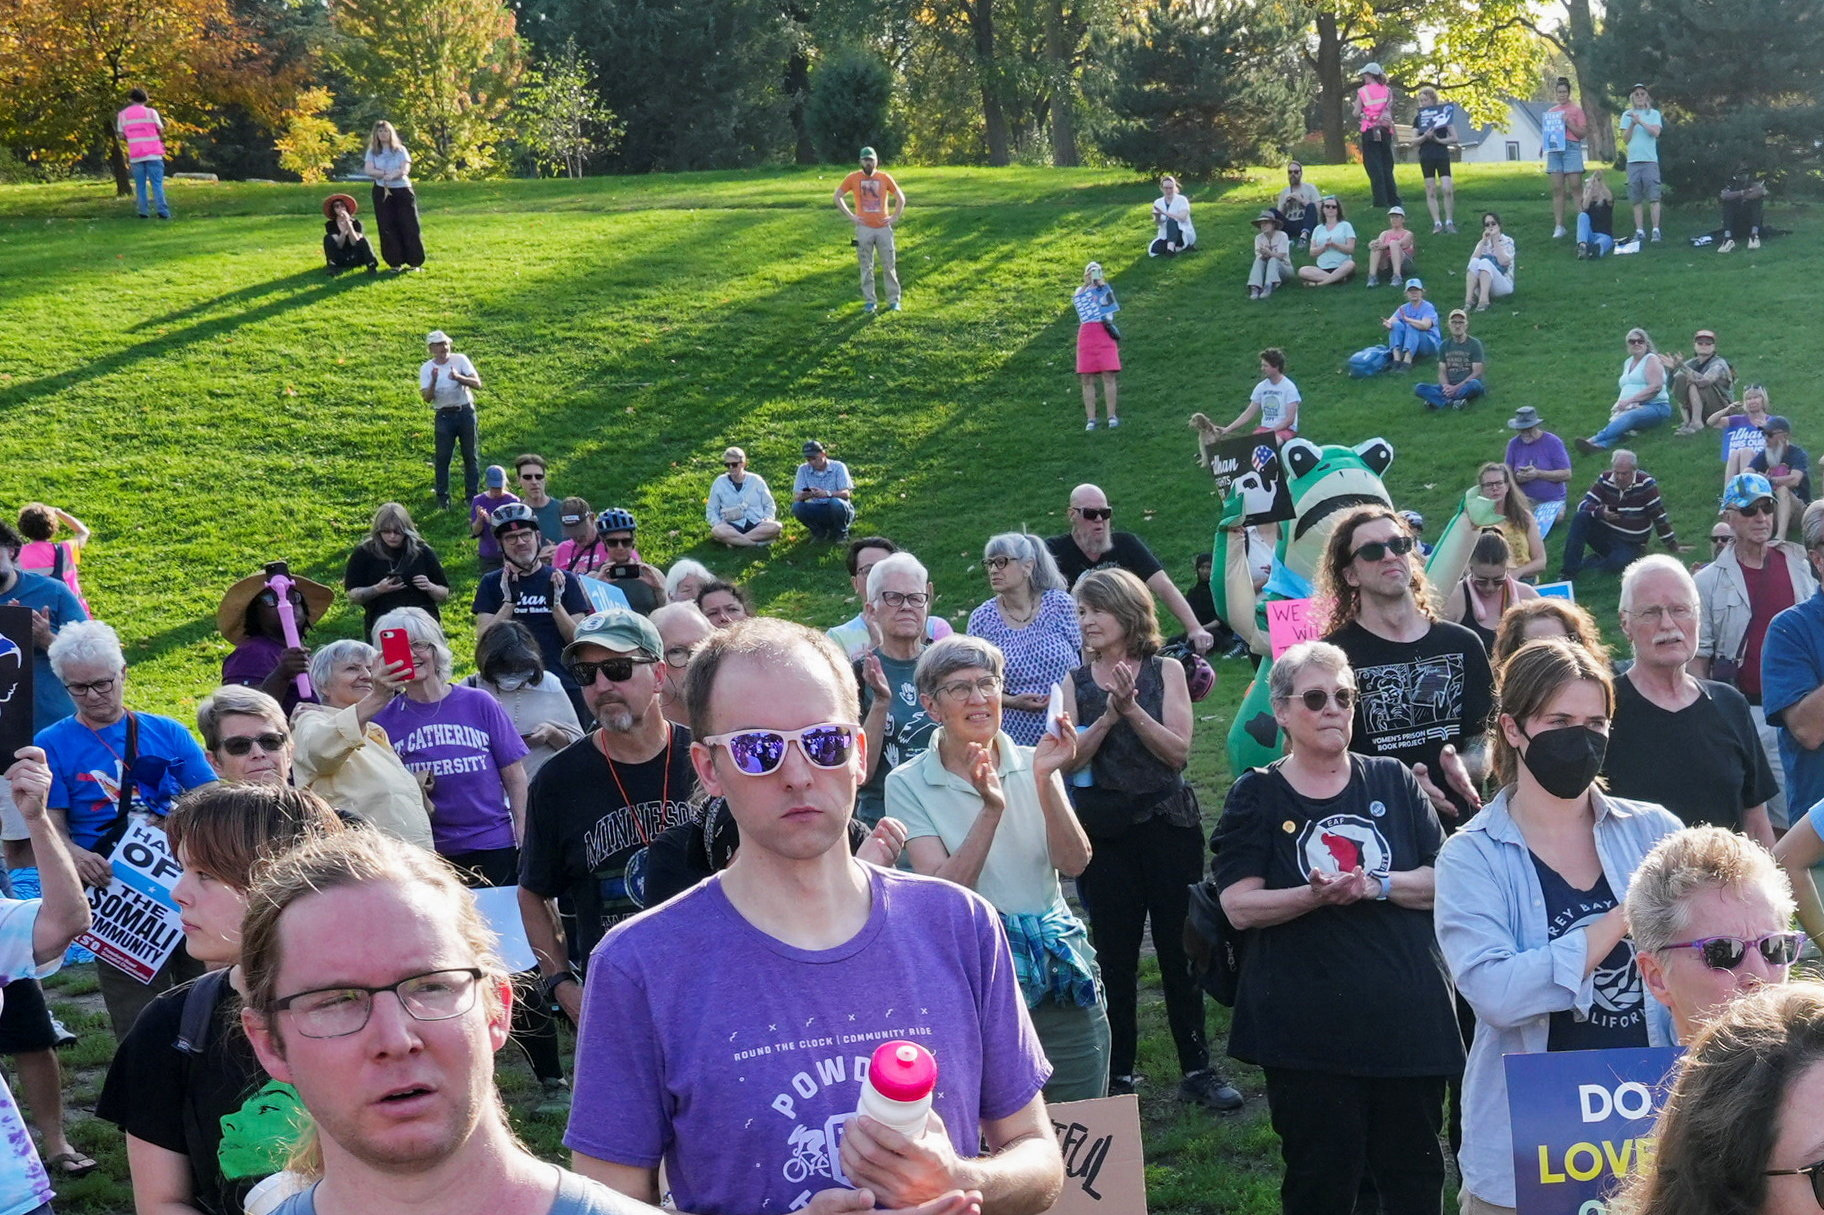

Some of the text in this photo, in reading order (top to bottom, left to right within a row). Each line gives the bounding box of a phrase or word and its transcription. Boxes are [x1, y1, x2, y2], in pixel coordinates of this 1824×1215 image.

[1272, 603, 1301, 622] WE
[407, 723, 490, 753] CATHERINE
[1377, 738, 1426, 752] BOOK PROJECT
[1402, 730, 1426, 741] PRISON
[404, 755, 488, 777] NIVERSITY
[584, 800, 691, 873] MINNESO
[1326, 817, 1345, 827] EAF
[122, 842, 184, 879] OF
[88, 886, 178, 952] SOMALI
[121, 884, 169, 920] THE
[1548, 900, 1613, 937] REY BAY
[90, 912, 165, 965] OMMUNITY
[1590, 1008, 1647, 1028] LIFOR
[734, 1026, 933, 1061] ROUND THE CLOCK COMMUNITY RIDE
[770, 1054, 872, 1121] POWD
[1578, 1081, 1652, 1123] DO
